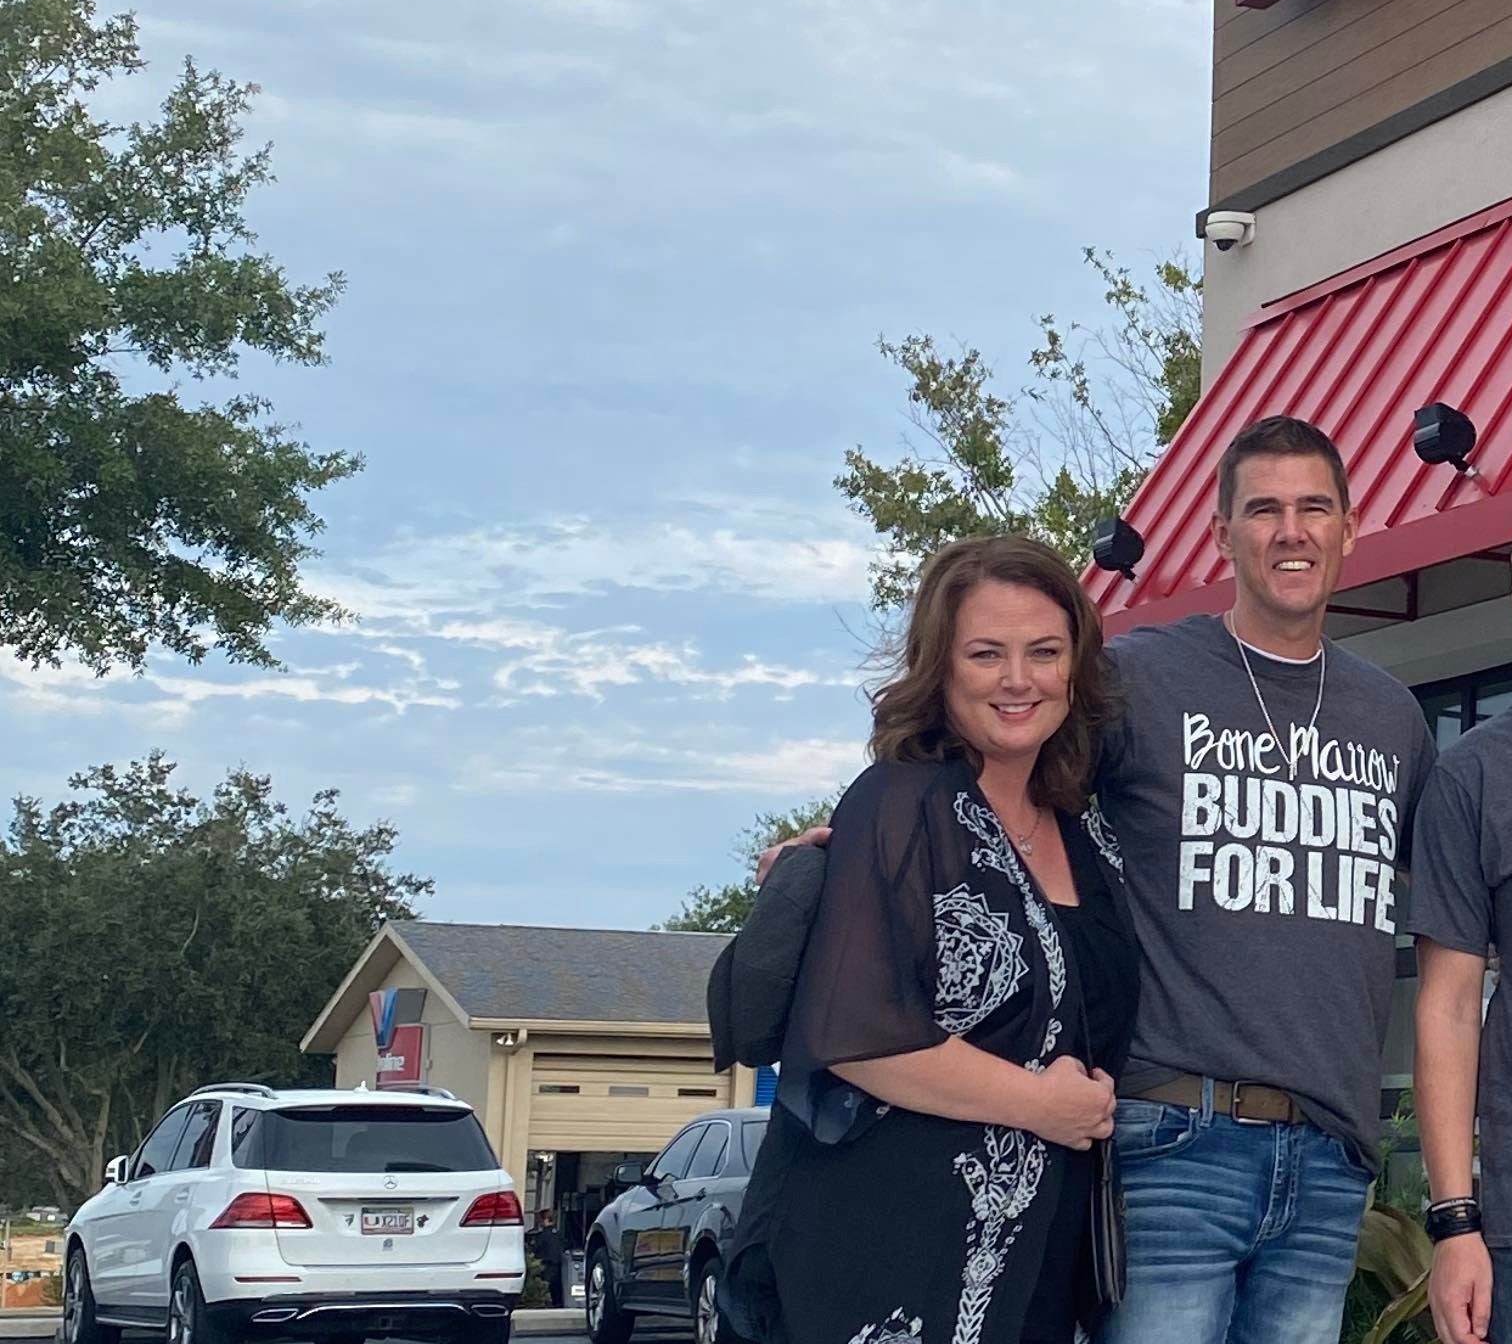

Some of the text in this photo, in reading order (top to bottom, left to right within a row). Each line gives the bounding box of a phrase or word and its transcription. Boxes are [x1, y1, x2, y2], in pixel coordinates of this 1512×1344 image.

[1183, 711, 1400, 795] Bone Marrow
[1181, 772, 1398, 862] BUDDIES
[1178, 840, 1396, 936] FOR LIFE
